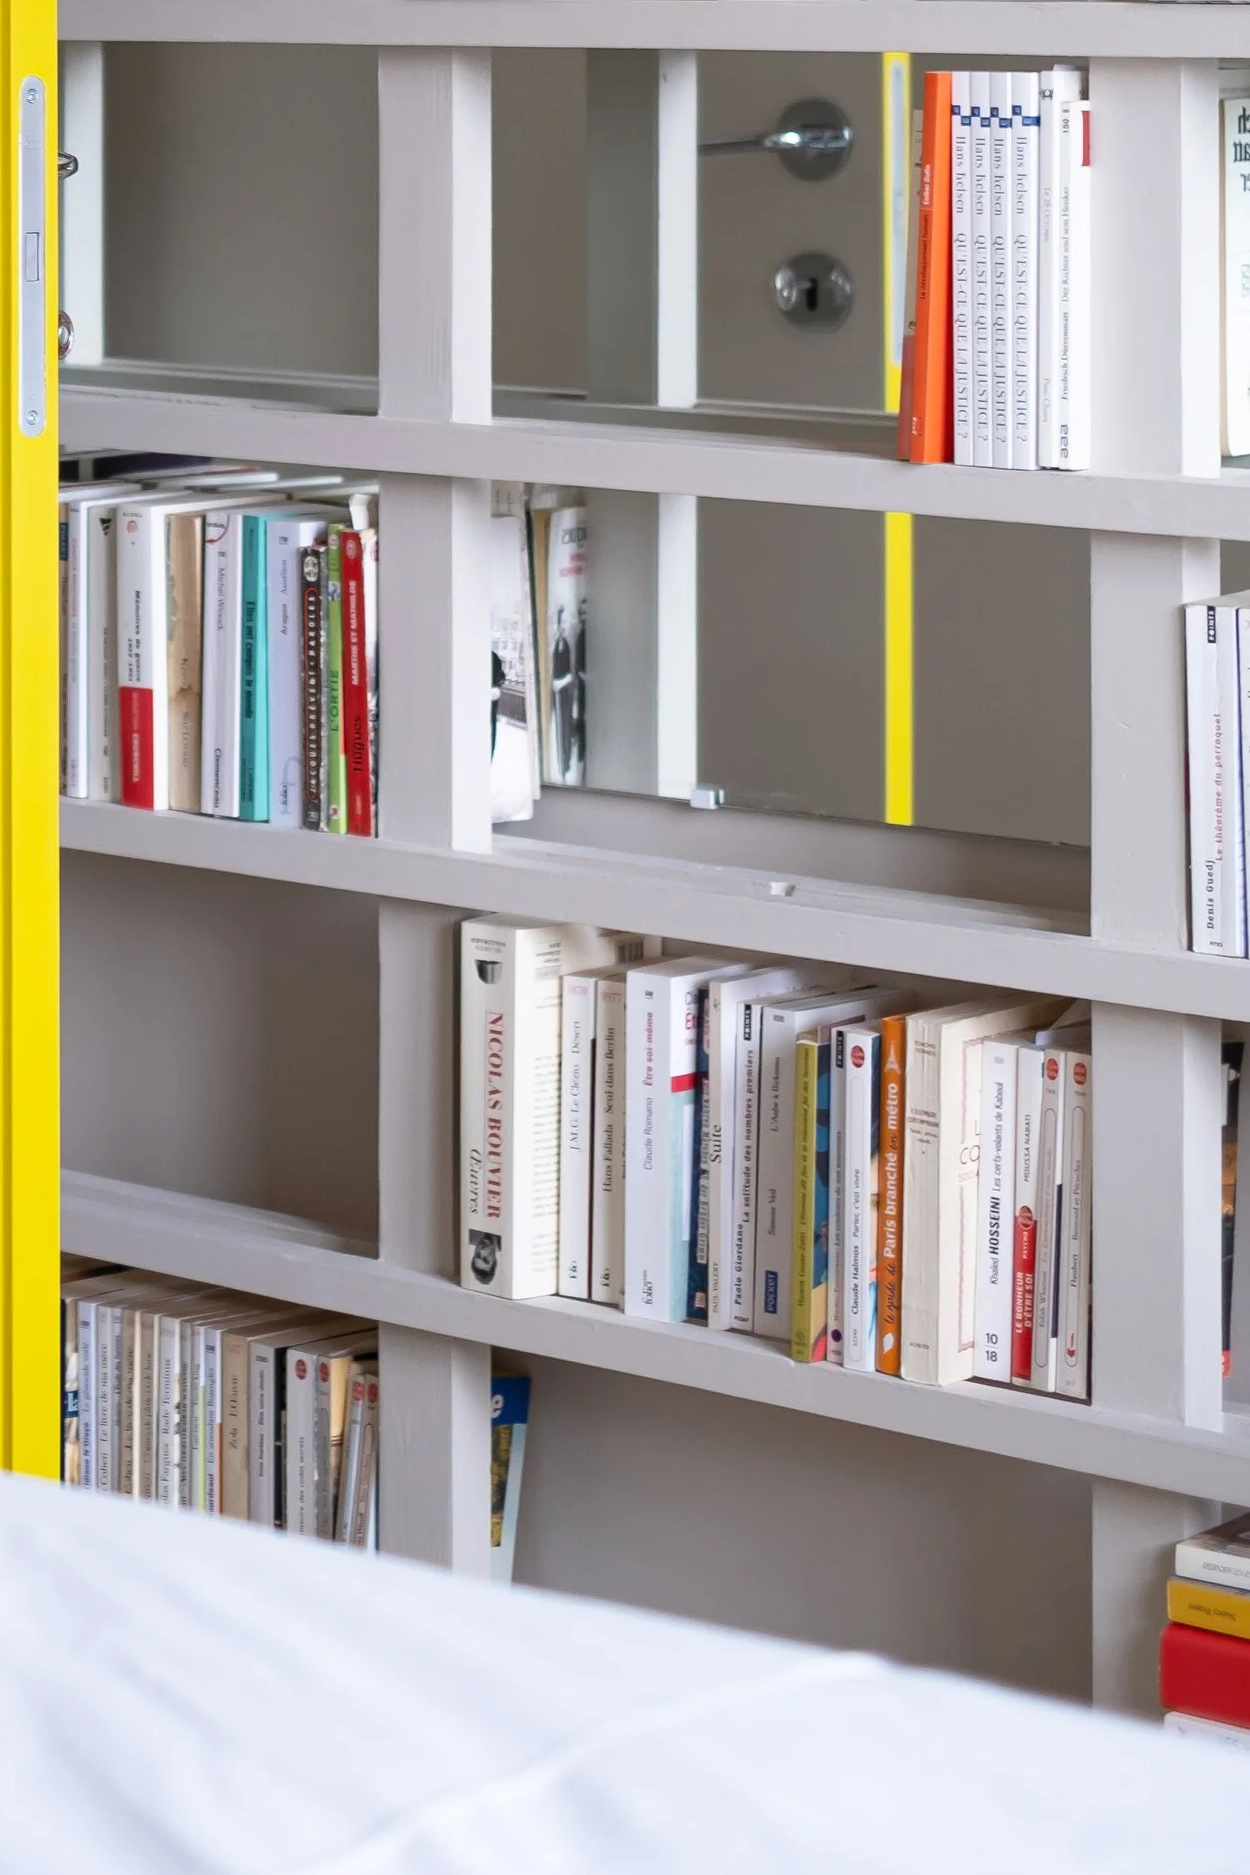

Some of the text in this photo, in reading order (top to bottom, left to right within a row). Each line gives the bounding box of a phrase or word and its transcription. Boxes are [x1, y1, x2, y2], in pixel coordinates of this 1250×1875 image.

[956, 136, 966, 166] Hans
[975, 137, 986, 169] Hans
[994, 138, 1005, 169] Hans
[1016, 137, 1027, 168] Hans
[955, 313, 967, 343] QUE
[976, 315, 988, 345] QUE
[994, 316, 1006, 346] QUE
[1014, 315, 1027, 345] QUE
[957, 348, 967, 365] LA
[977, 350, 987, 367] LA
[995, 351, 1006, 368] LA
[1016, 350, 1027, 367] LA
[955, 368, 967, 427] JUSTICE
[975, 370, 988, 429] JUSTICE
[994, 372, 1006, 431] JUSTICE
[1014, 371, 1027, 430] JUSTICE
[307, 596, 316, 656] PAROLES
[213, 748, 223, 809] Clemenceau
[1213, 713, 1223, 861] Le théorème du perroquet
[1205, 859, 1215, 929] Denis Guedj
[487, 1011, 504, 1219] NICOLAS BOUVIER
[602, 1027, 615, 1193] Hans Fallada Seul dans Berlin
[642, 1097, 652, 1136] Romano
[886, 1082, 898, 1130] métro
[643, 1139, 653, 1171] Claude
[709, 1124, 722, 1164] Suite
[742, 1049, 754, 1224] La solitude des nombres premiers
[1023, 1114, 1031, 1183] MOUSSA NABATI
[469, 1149, 483, 1216] Œuvres
[884, 1152, 897, 1215] branché
[988, 1082, 1004, 1286] Khaled HOSSEINI Les cerfs-volants de Kaboul
[883, 1219, 896, 1258] Paris
[734, 1223, 744, 1306] Paolo Giordano
[851, 1245, 860, 1280] Halmos
[765, 1273, 776, 1312] POCKET
[851, 1283, 859, 1315] Claude
[1014, 1272, 1024, 1334] LE BONHEUR
[1023, 1274, 1034, 1328] D'ÊTRE SOI
[985, 1333, 998, 1345] 10
[985, 1351, 998, 1363] 18
